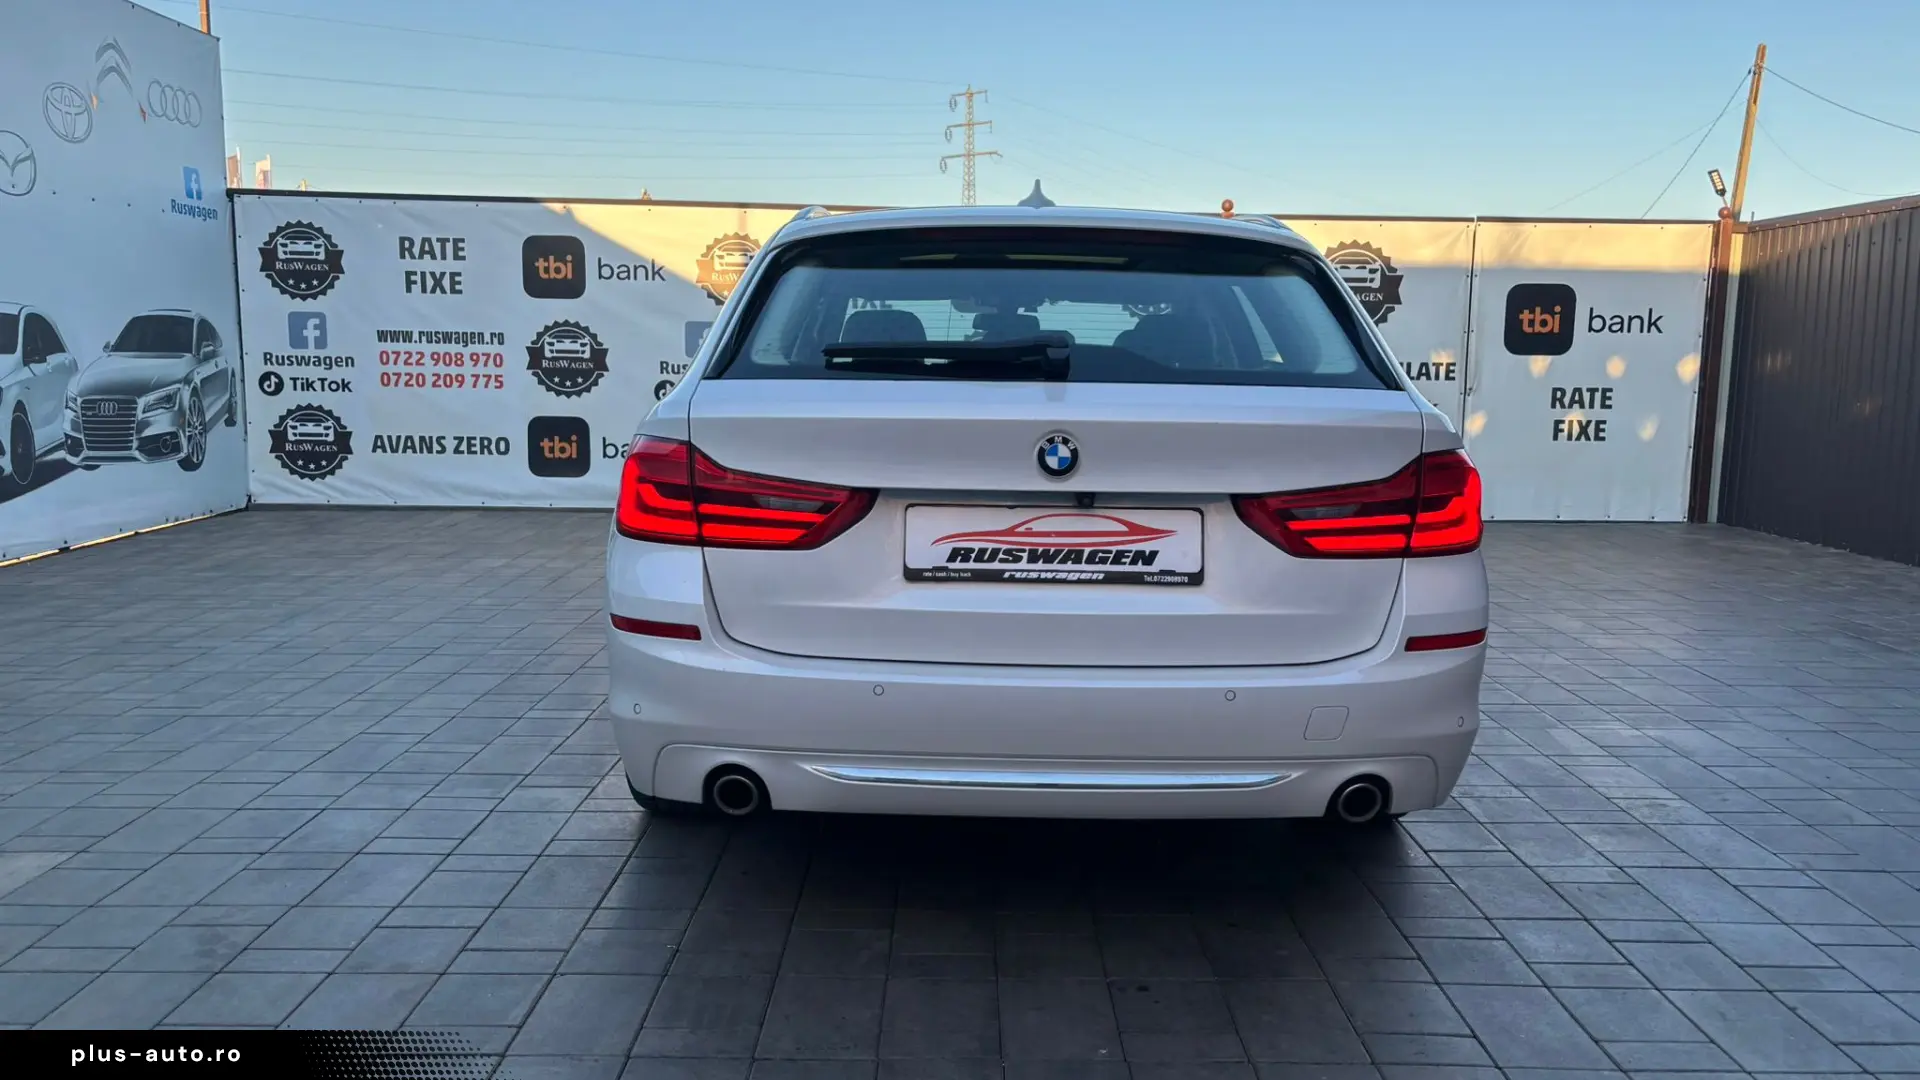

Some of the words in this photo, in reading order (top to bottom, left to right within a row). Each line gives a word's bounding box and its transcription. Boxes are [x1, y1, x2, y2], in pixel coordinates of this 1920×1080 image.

[171, 199, 218, 221] Ruswagen
[398, 236, 467, 261] RATE
[534, 255, 573, 280] tbi
[597, 257, 667, 282] bank
[404, 270, 464, 295] FIXE
[1518, 306, 1562, 333] tbi
[1587, 308, 1664, 334] bank
[376, 330, 505, 348] www.ruswagen.ro
[263, 352, 355, 370] Ruswagen
[379, 350, 426, 366] 0722
[430, 351, 465, 367] 908
[469, 352, 504, 368] 970
[380, 371, 426, 388] 0720
[431, 372, 466, 389] 209
[471, 373, 504, 390] 775
[1400, 362, 1456, 381] LATE
[289, 377, 353, 392] TikTok
[1550, 387, 1614, 410] RATE
[1552, 419, 1607, 441] FIXE
[371, 435, 447, 455] AVANS
[452, 436, 511, 455] ZERO
[540, 435, 578, 459] tbi
[602, 436, 629, 459] ba
[946, 547, 1160, 567] RUSWAGEN
[1003, 570, 1105, 581] ruswagen
